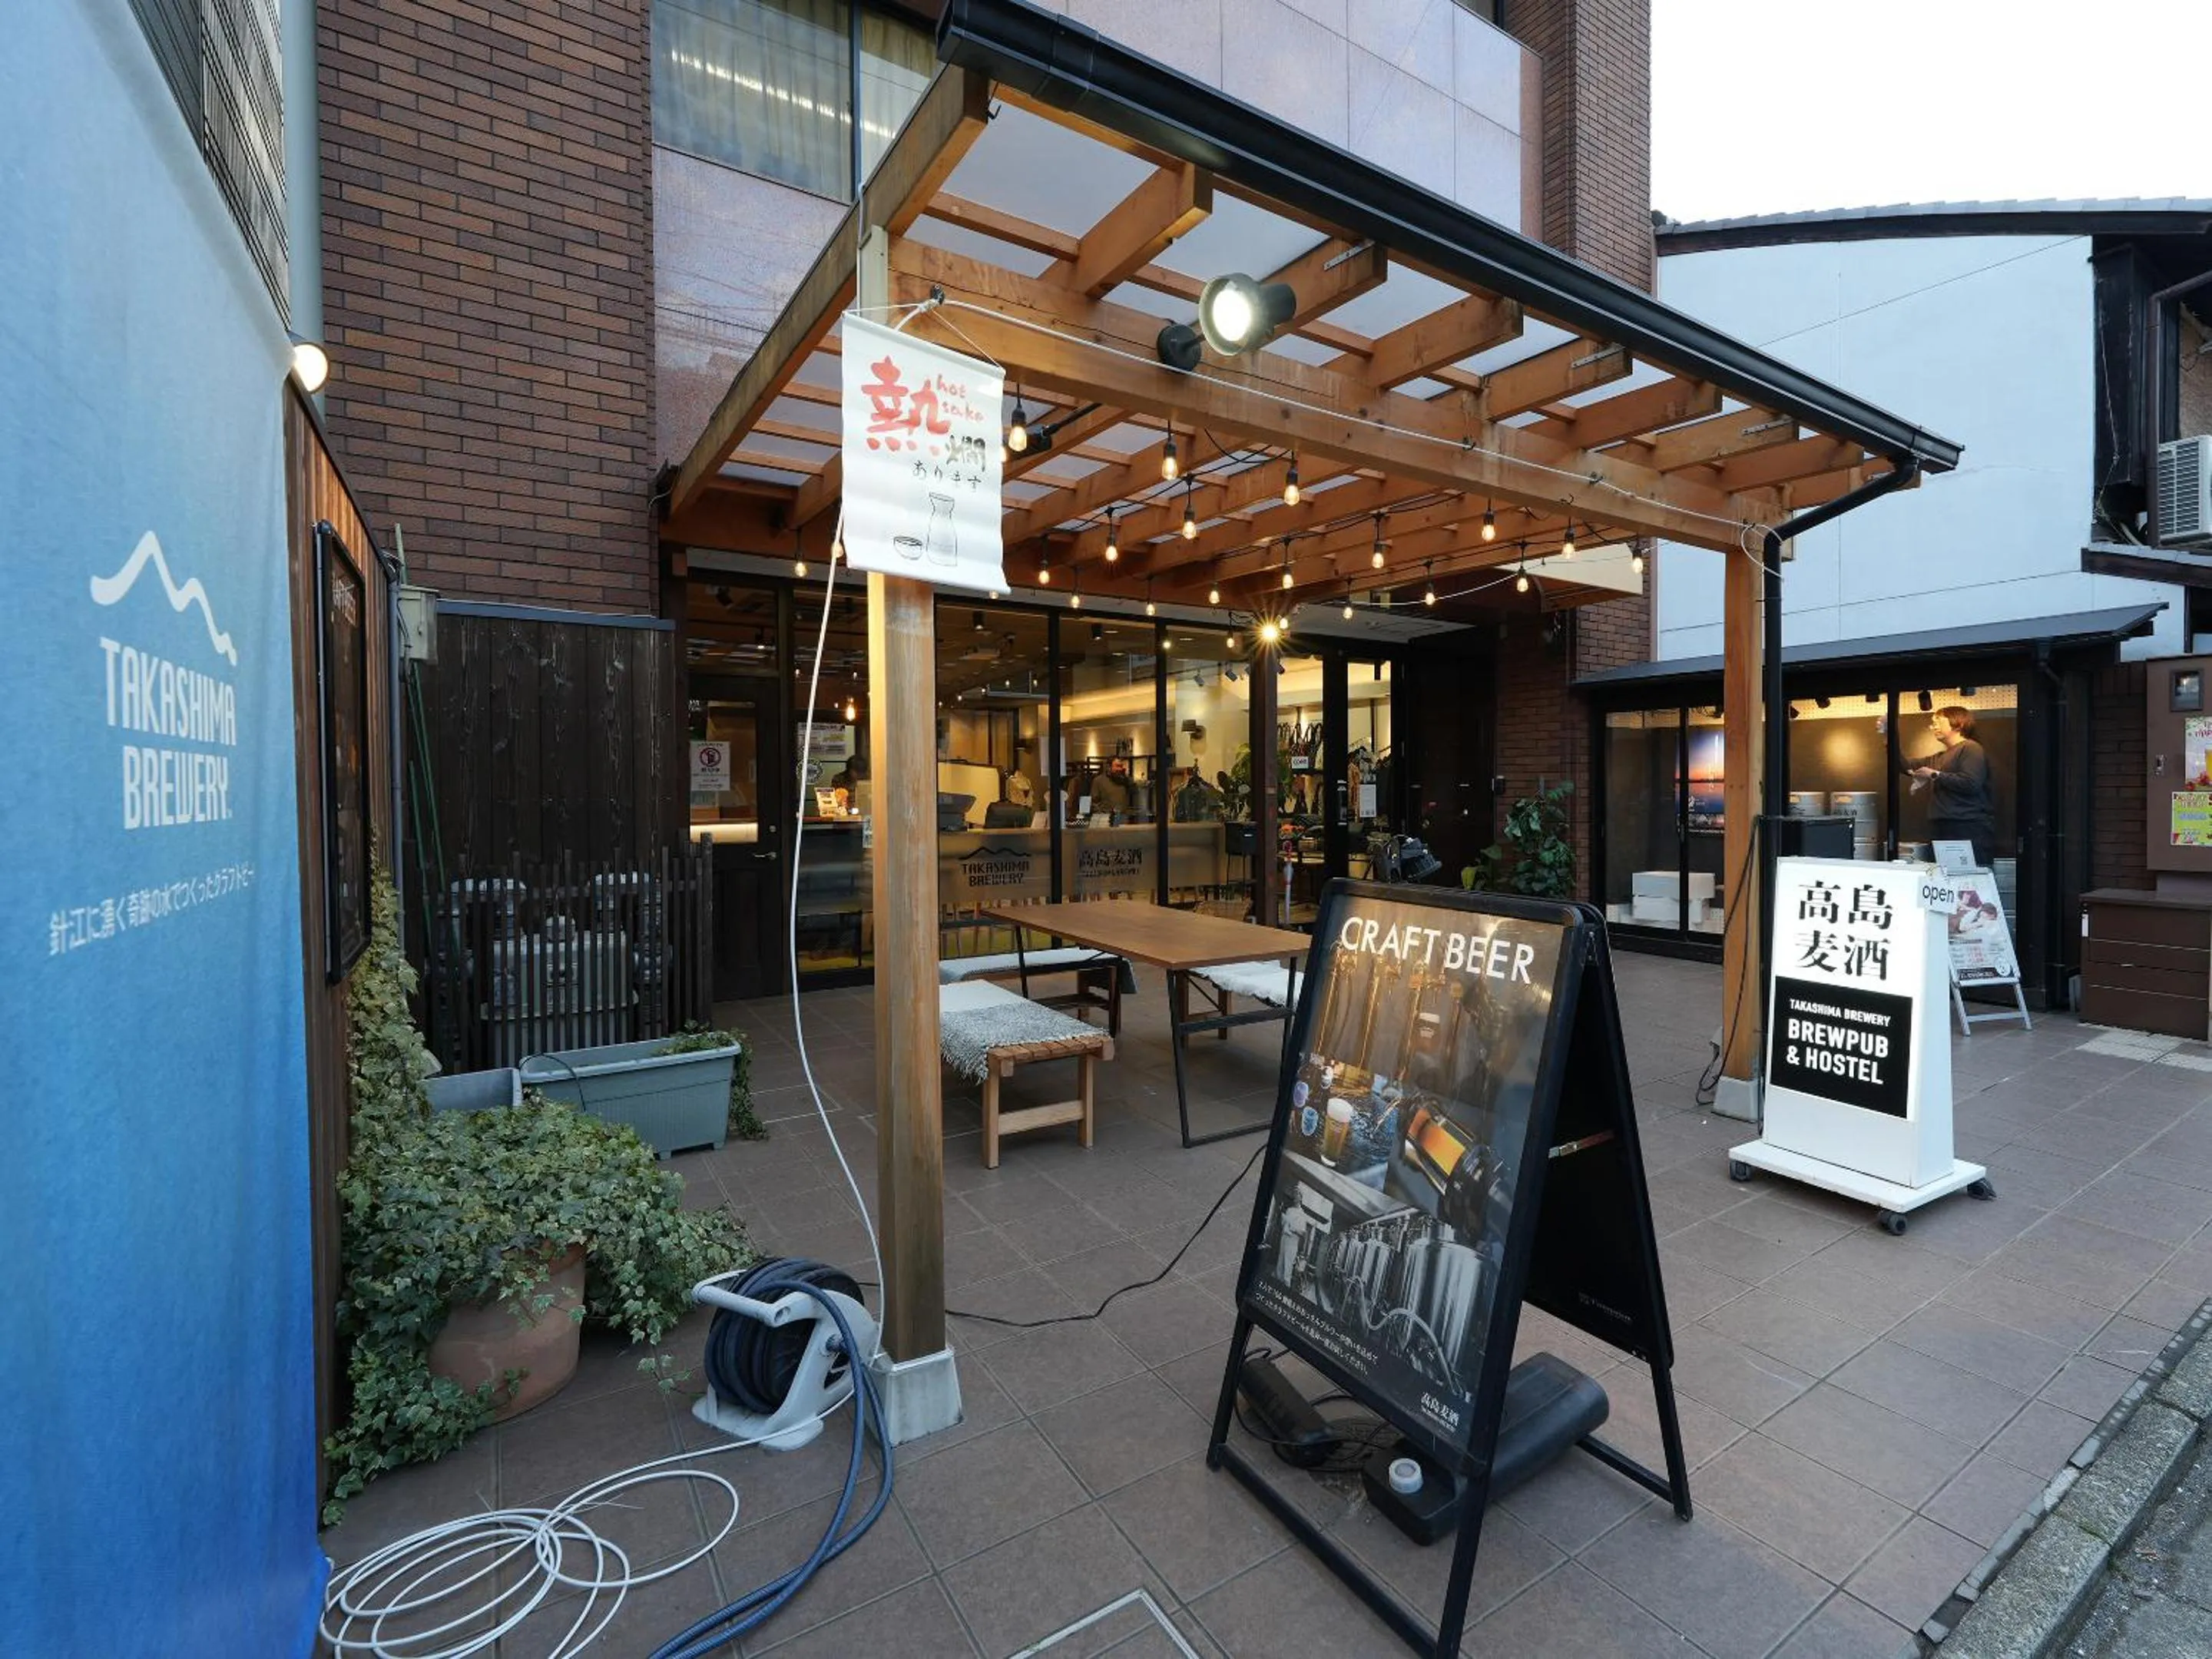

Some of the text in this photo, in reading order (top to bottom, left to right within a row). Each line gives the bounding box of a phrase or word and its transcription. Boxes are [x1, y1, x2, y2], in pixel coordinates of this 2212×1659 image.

[937, 374, 966, 399] hot
[942, 402, 984, 422] sake
[912, 460, 982, 492] あります
[100, 637, 237, 747] TAKASHIMA
[962, 861, 1029, 874] TAKASHIMA
[1798, 880, 1893, 930] 高島
[1922, 885, 1955, 906] open
[1341, 916, 1535, 984] CRAFT BEER
[1795, 929, 1892, 981] 麦酒
[1790, 998, 1891, 1027] TAKASHIMA BREWERY
[1788, 1018, 1889, 1058] BREWPUB
[1786, 1045, 1883, 1084] & HOSTEL
